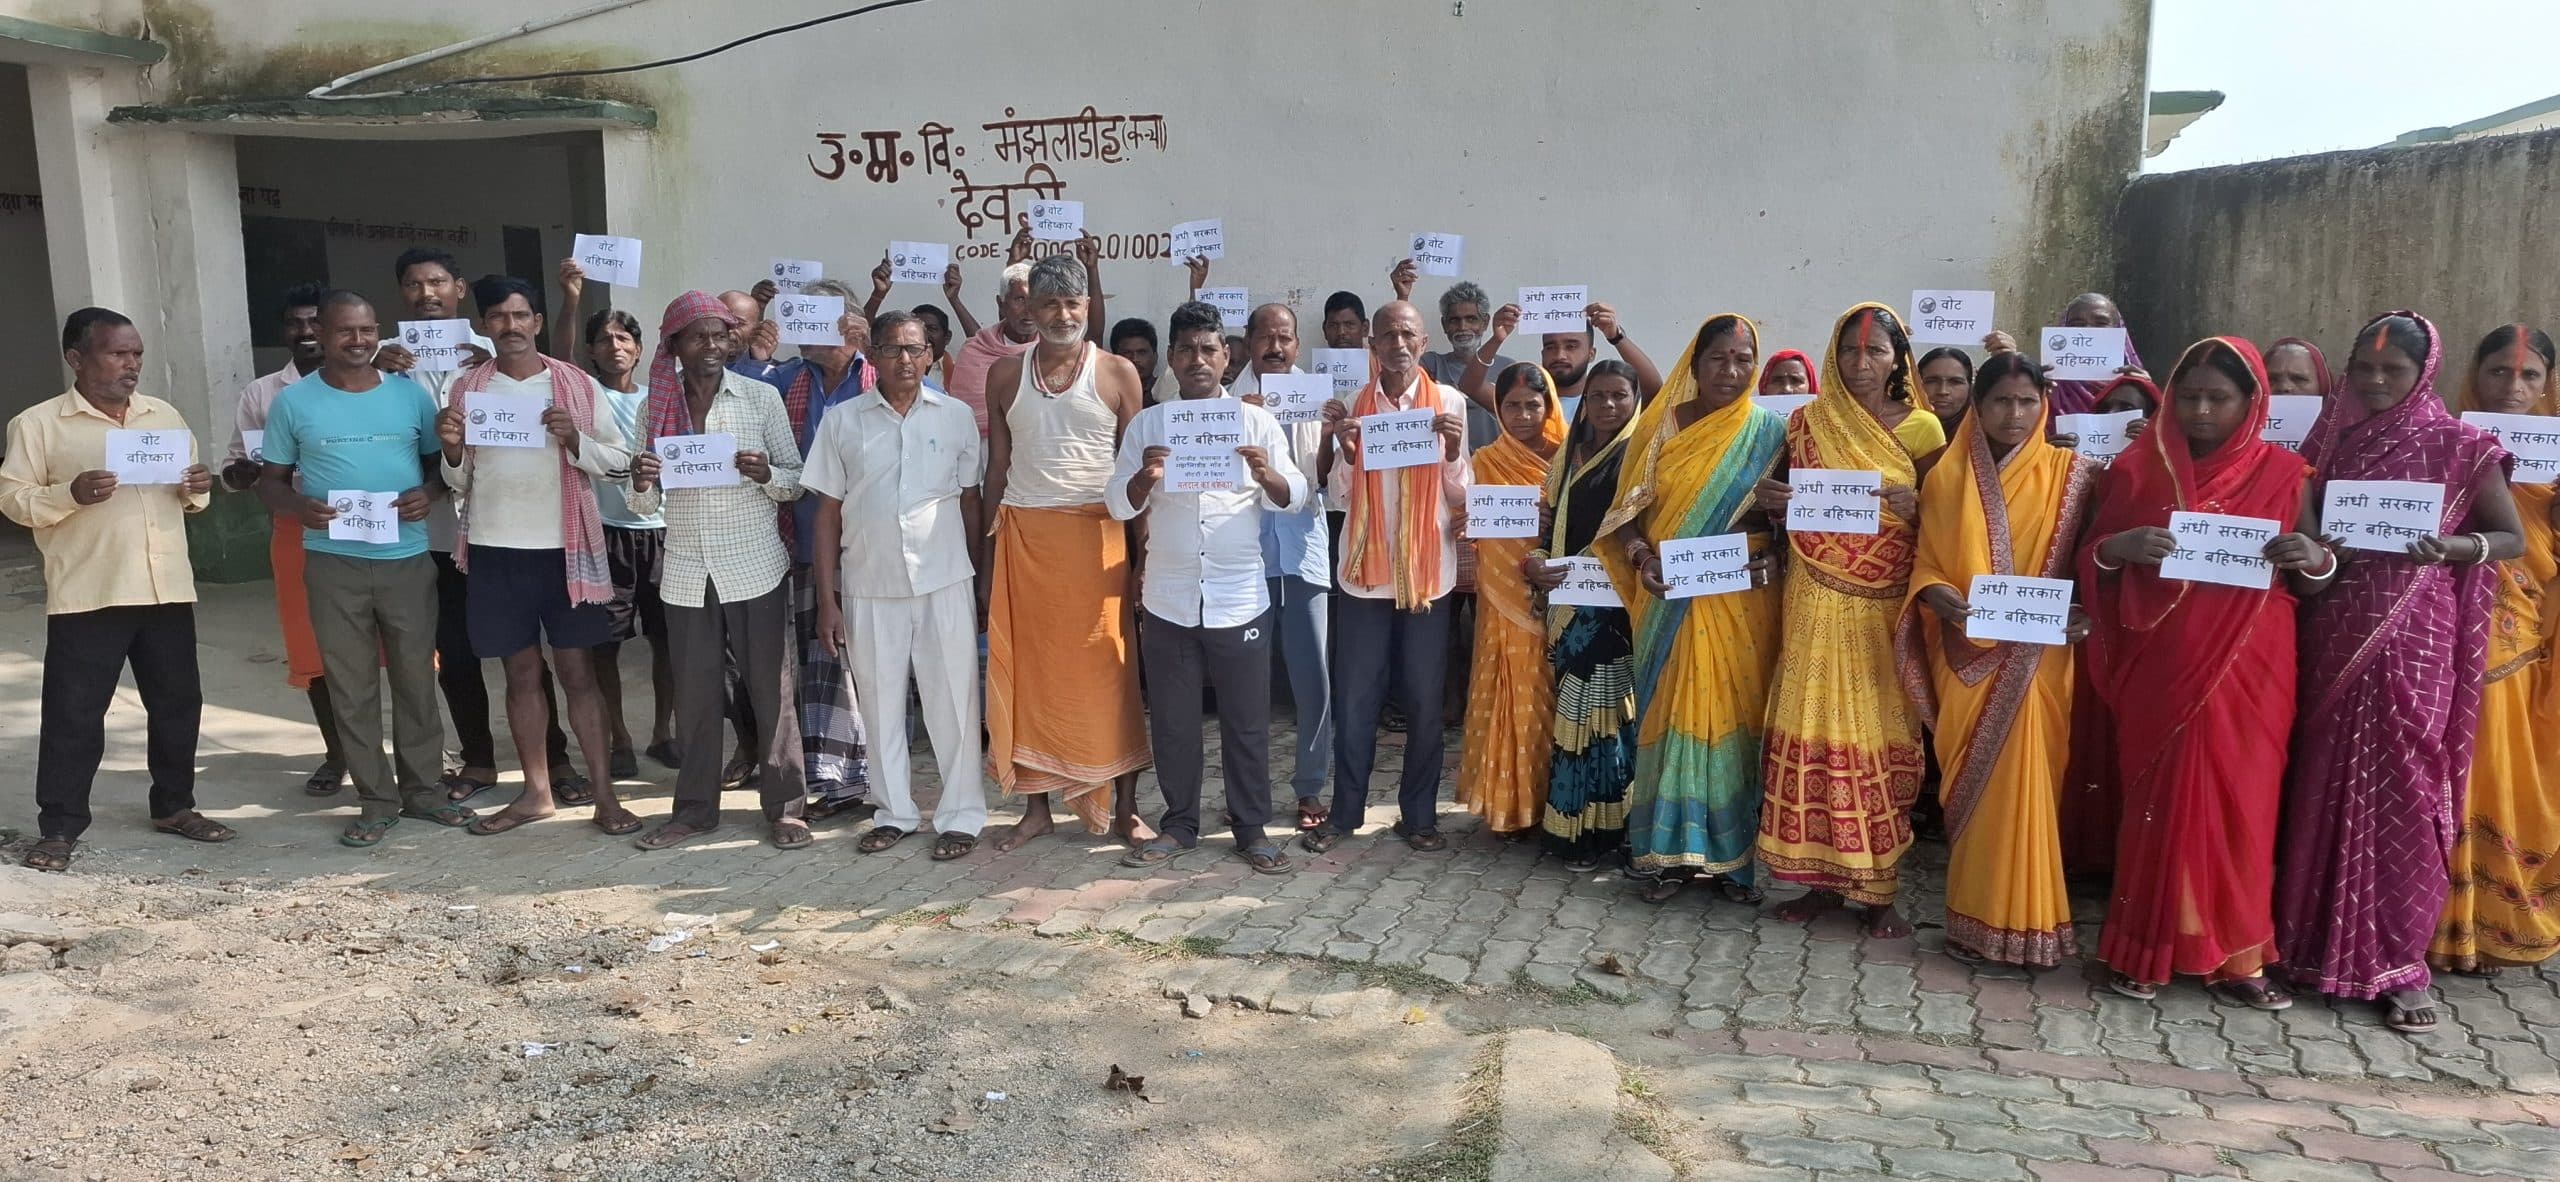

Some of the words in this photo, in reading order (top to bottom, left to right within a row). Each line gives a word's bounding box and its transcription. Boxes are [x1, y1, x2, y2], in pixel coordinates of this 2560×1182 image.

[1048, 204, 1063, 215] वोट
[598, 240, 615, 251] वोट
[1428, 237, 1444, 249] वोट
[911, 255, 928, 265] वोट
[1550, 292, 1581, 302] सरकार
[797, 300, 818, 313] वोट
[1941, 297, 1962, 310] वोट
[1523, 310, 1538, 321] वोट
[423, 327, 444, 339] वोट
[2072, 333, 2093, 346] वोट
[1333, 362, 1348, 373] वोट
[1287, 391, 1307, 403] वोट
[493, 409, 516, 422] वोट
[1201, 411, 1236, 422] सरकार
[1395, 420, 1428, 431] सरकार
[140, 433, 160, 446] वोट
[1169, 433, 1188, 445] वोट
[2088, 430, 2112, 444] वोट
[2510, 431, 2560, 445] सरकार
[684, 441, 705, 454] वोट
[1367, 443, 1384, 454] वोट
[1832, 484, 1873, 495] सरकार
[1500, 497, 1535, 507] सरकार
[2379, 497, 2434, 513] सरकार
[1794, 505, 1816, 518] वोट
[1470, 517, 1487, 528] वोट
[2328, 519, 2356, 533] वोट
[2218, 525, 2269, 541] सरकार
[1702, 547, 1741, 561] सरकार
[2171, 546, 2197, 561] वोट
[1669, 574, 1689, 586] वोट
[2017, 586, 2064, 600] सरकार
[1973, 607, 1997, 620] वोट
